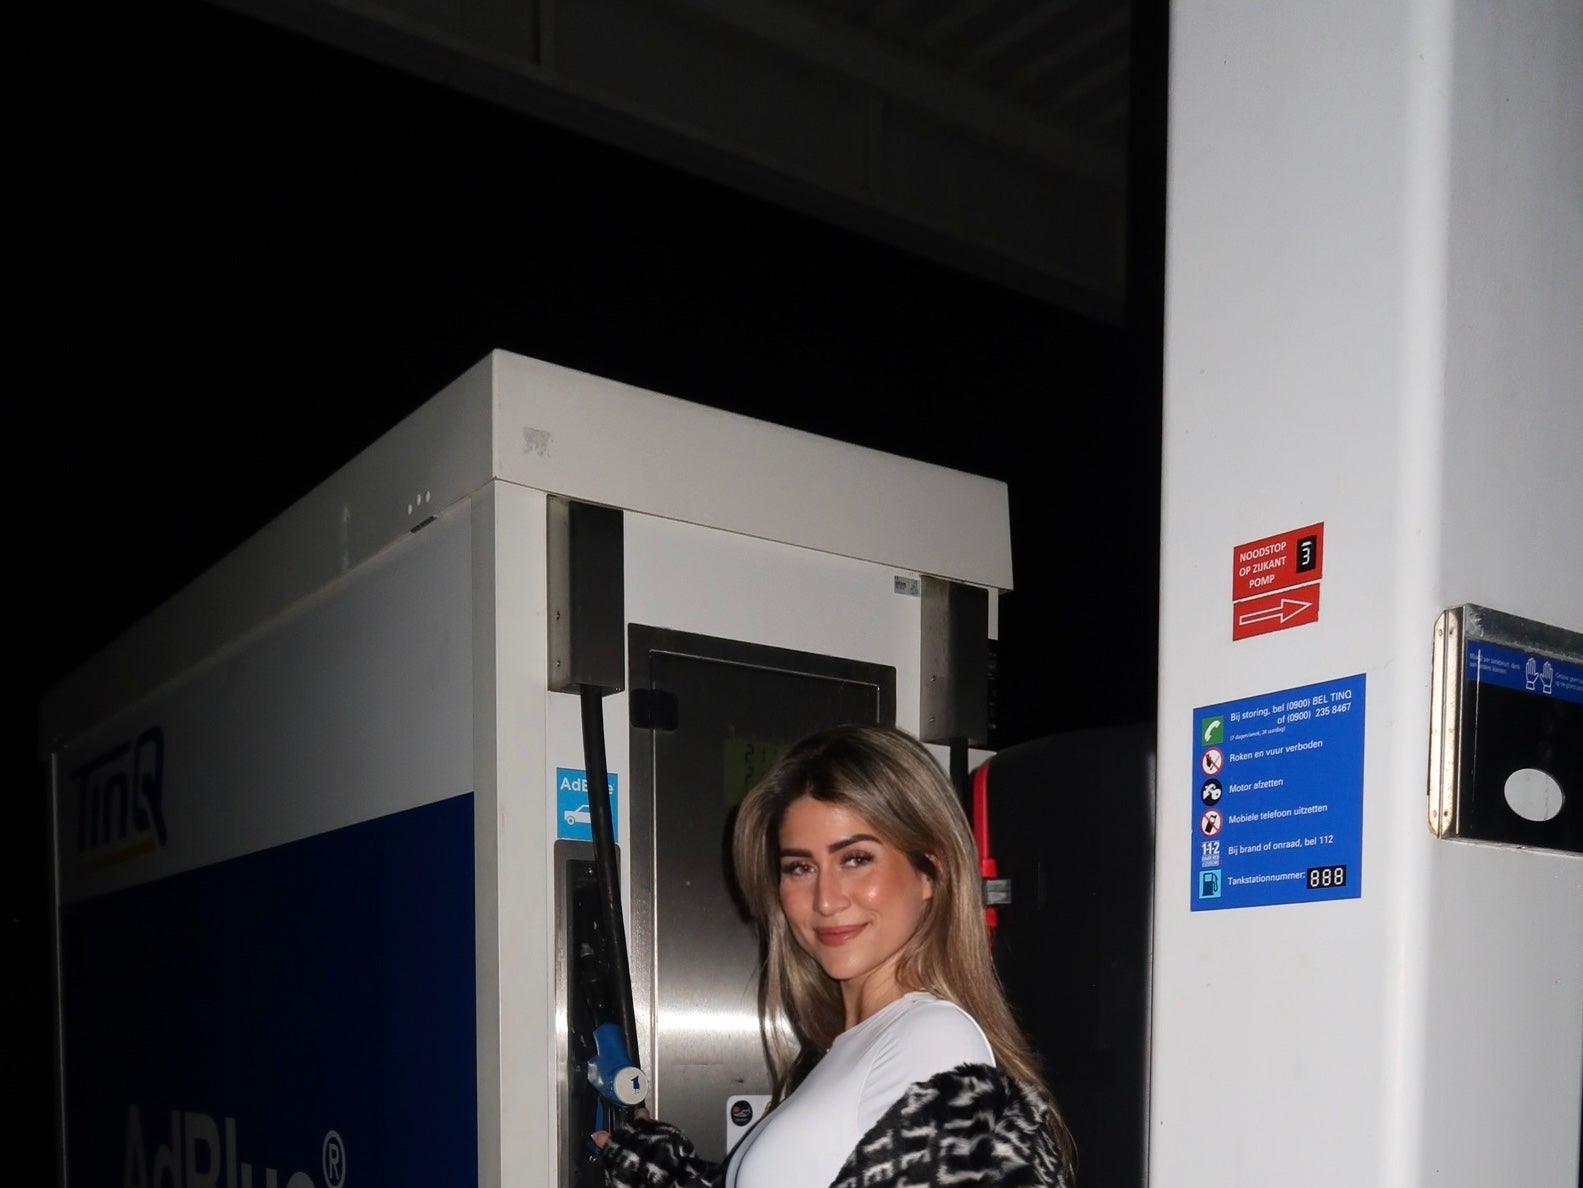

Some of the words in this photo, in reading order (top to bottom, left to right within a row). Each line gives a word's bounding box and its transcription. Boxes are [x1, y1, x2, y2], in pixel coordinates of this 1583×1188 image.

[1239, 541, 1288, 563] NOODSTOP
[1239, 566, 1251, 577] OP
[1252, 556, 1287, 574] ZIJKANT
[1248, 574, 1276, 589] POMP
[1230, 711, 1240, 723] Bij
[1241, 707, 1271, 720] storing,
[1272, 703, 1285, 714] bel
[1286, 698, 1311, 712] (0900)
[1312, 694, 1329, 706] BEL
[1330, 689, 1352, 702] TINQ
[1277, 714, 1286, 725] of
[1287, 710, 1312, 723] (0900)
[1315, 706, 1331, 718] 235
[1331, 702, 1352, 715] 8467
[1229, 752, 1253, 763] Roken
[1254, 750, 1264, 759] en
[1266, 747, 1284, 757] vuur
[1285, 740, 1323, 753] verboden
[1229, 784, 1252, 793] Motor
[1253, 778, 1284, 790] afzetten
[1228, 812, 1259, 824] Mobiele
[1260, 808, 1292, 820] telefoon
[1293, 804, 1328, 816] uitzetten
[1228, 845, 1238, 856] Bij
[1239, 843, 1262, 854] brand
[1263, 841, 1271, 851] of
[1272, 839, 1303, 850] onraad,
[1304, 837, 1317, 847] bel
[1319, 835, 1334, 844] 112
[1227, 871, 1306, 885] Tankstationnummer:
[1310, 867, 1344, 888] 888
